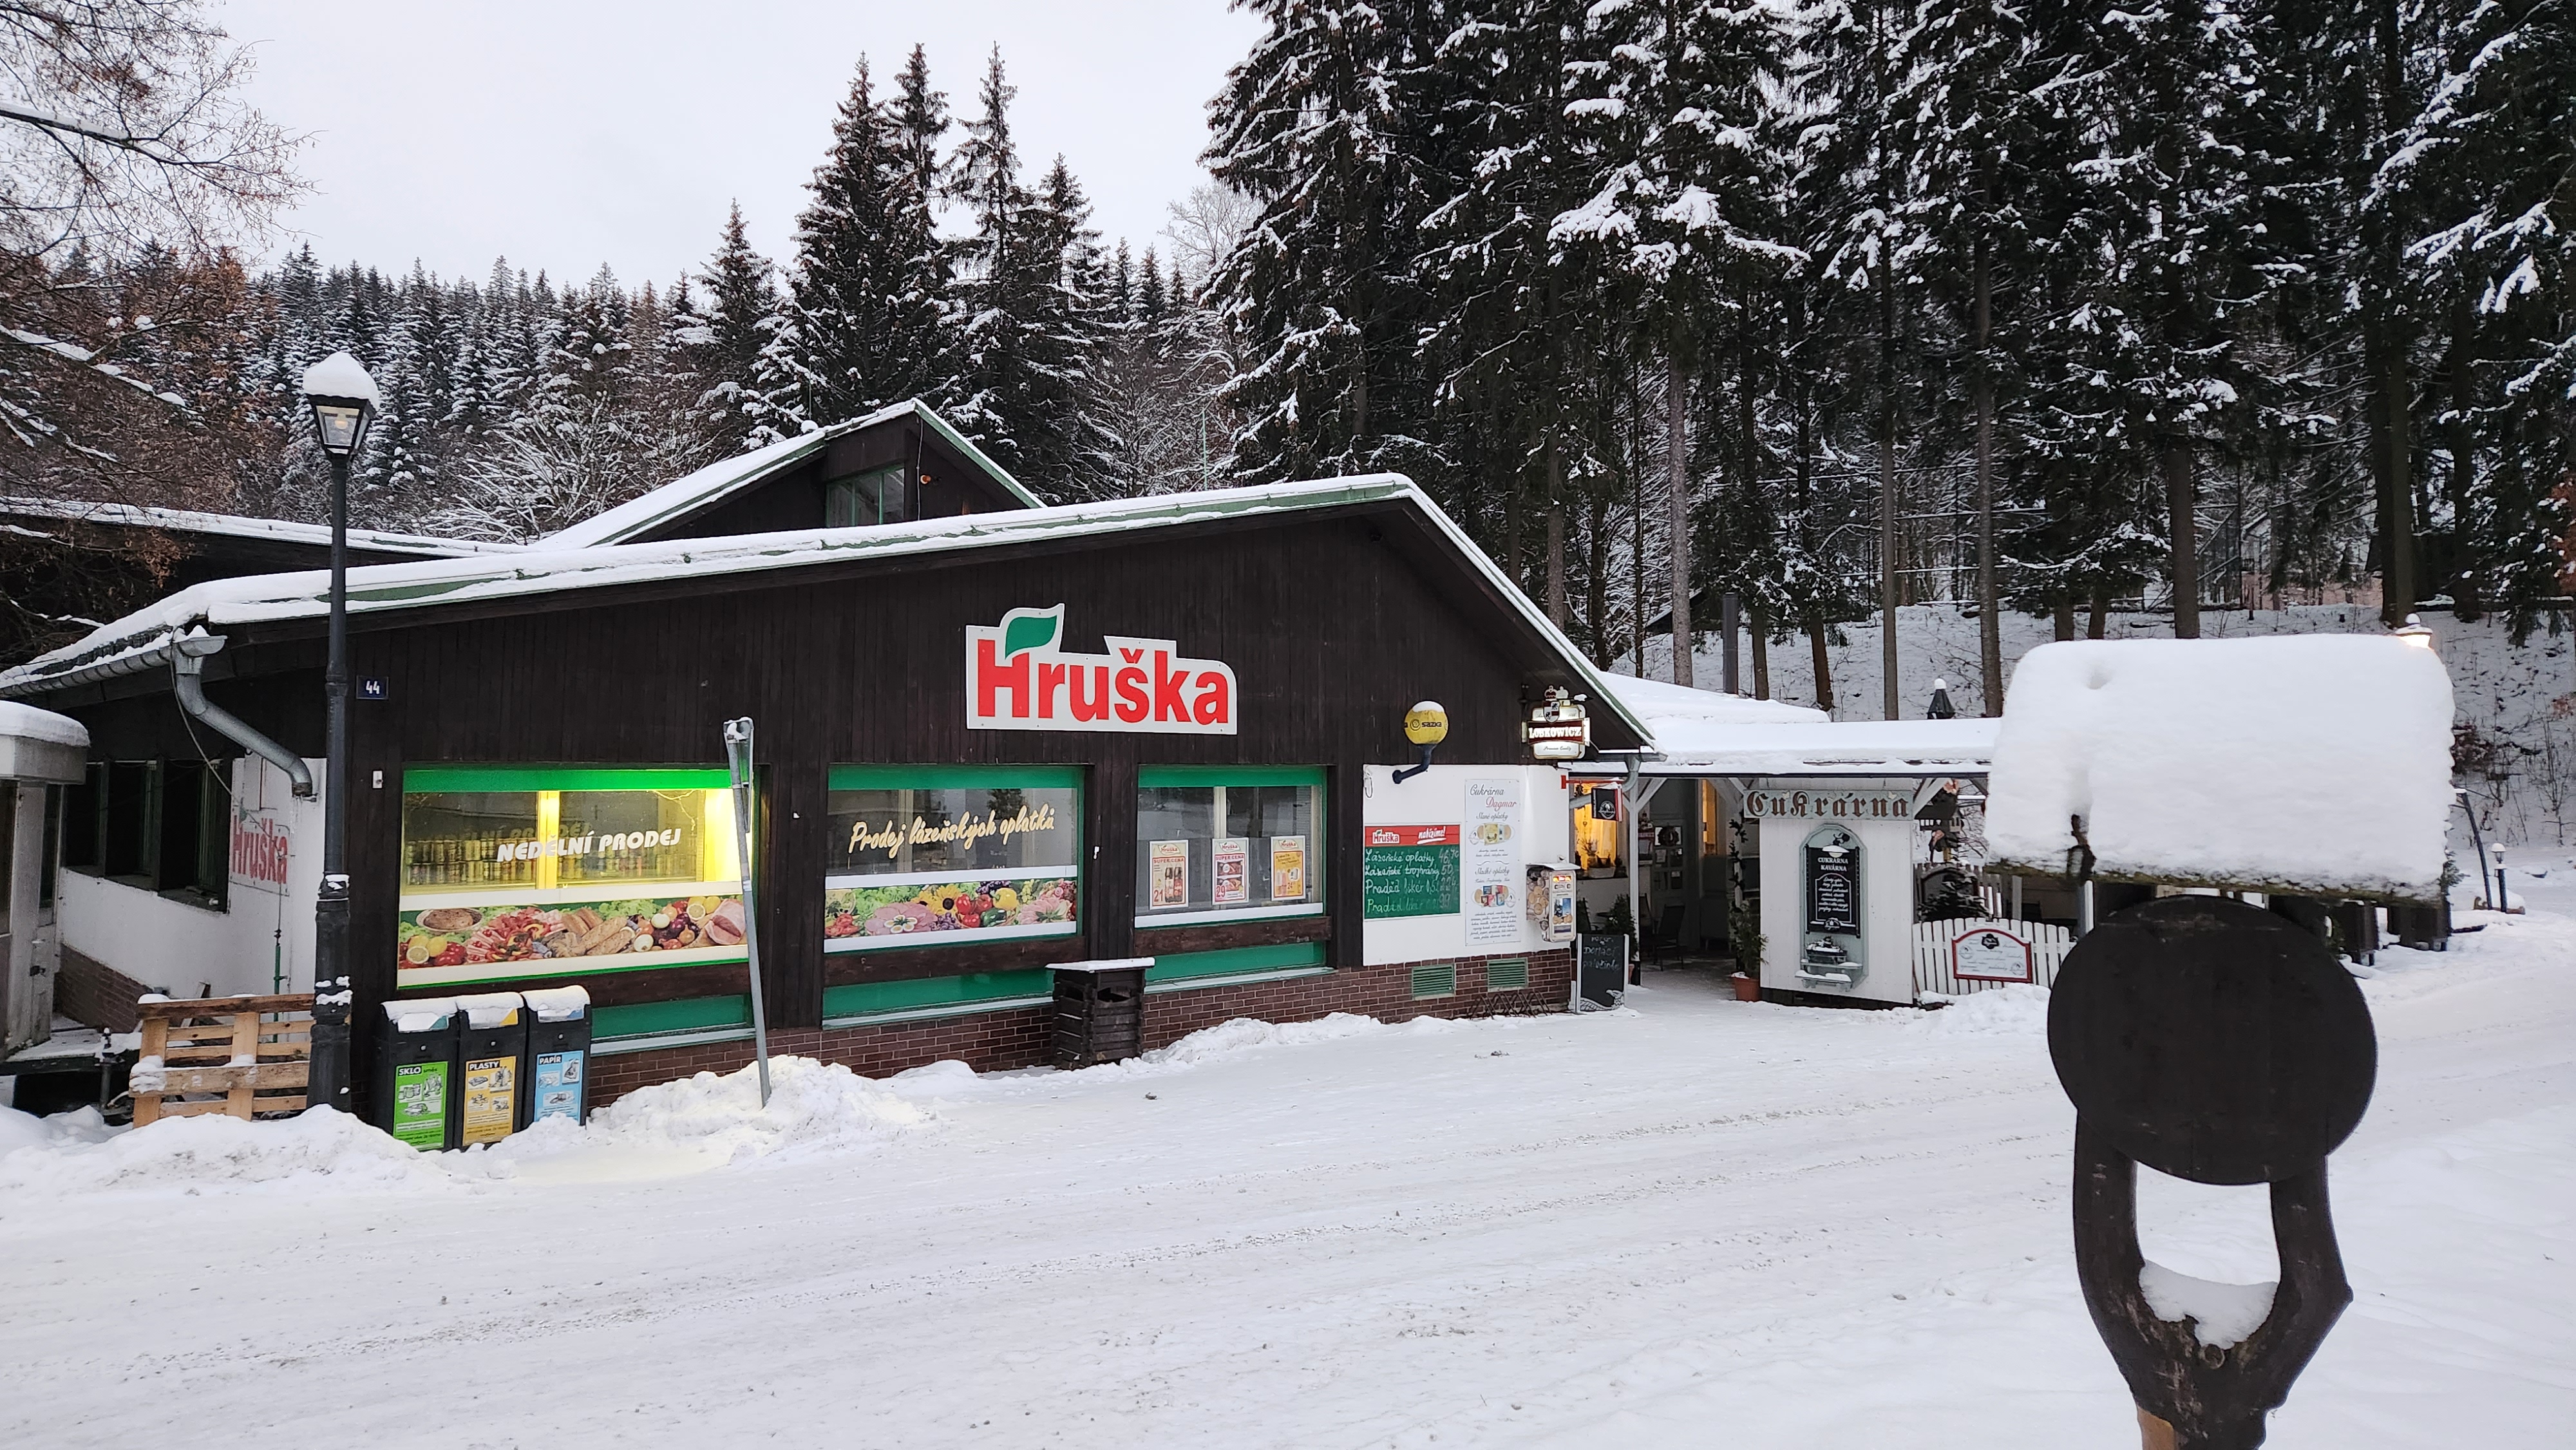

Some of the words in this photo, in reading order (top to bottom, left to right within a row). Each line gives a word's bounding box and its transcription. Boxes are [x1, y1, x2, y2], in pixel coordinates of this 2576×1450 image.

[365, 680, 381, 695] 44
[977, 639, 1229, 726] Hruška
[1528, 726, 1582, 739] LOBKOWICZ
[1469, 784, 1505, 796] Cukrárna
[1485, 796, 1517, 812] Dagmar
[848, 819, 907, 859] Prodej
[909, 809, 998, 851] lázeňských
[999, 802, 1056, 845] oplatků
[1373, 833, 1399, 843] Hruška
[1417, 825, 1446, 840] nabízíme!
[232, 814, 289, 885] Hruška
[496, 829, 595, 863] NEDĚLNÍ
[598, 828, 681, 852] PRODEJ
[1365, 848, 1404, 863] Lázeňské
[1405, 851, 1435, 868] oplatky
[1365, 865, 1402, 876] Lázeňské
[1216, 885, 1226, 898] 29
[1365, 878, 1401, 895] Praděd
[1153, 889, 1164, 902] 21
[468, 1060, 500, 1071] PLASTY
[538, 1055, 562, 1064] PAPÍR
[398, 1066, 421, 1076] SKLO
